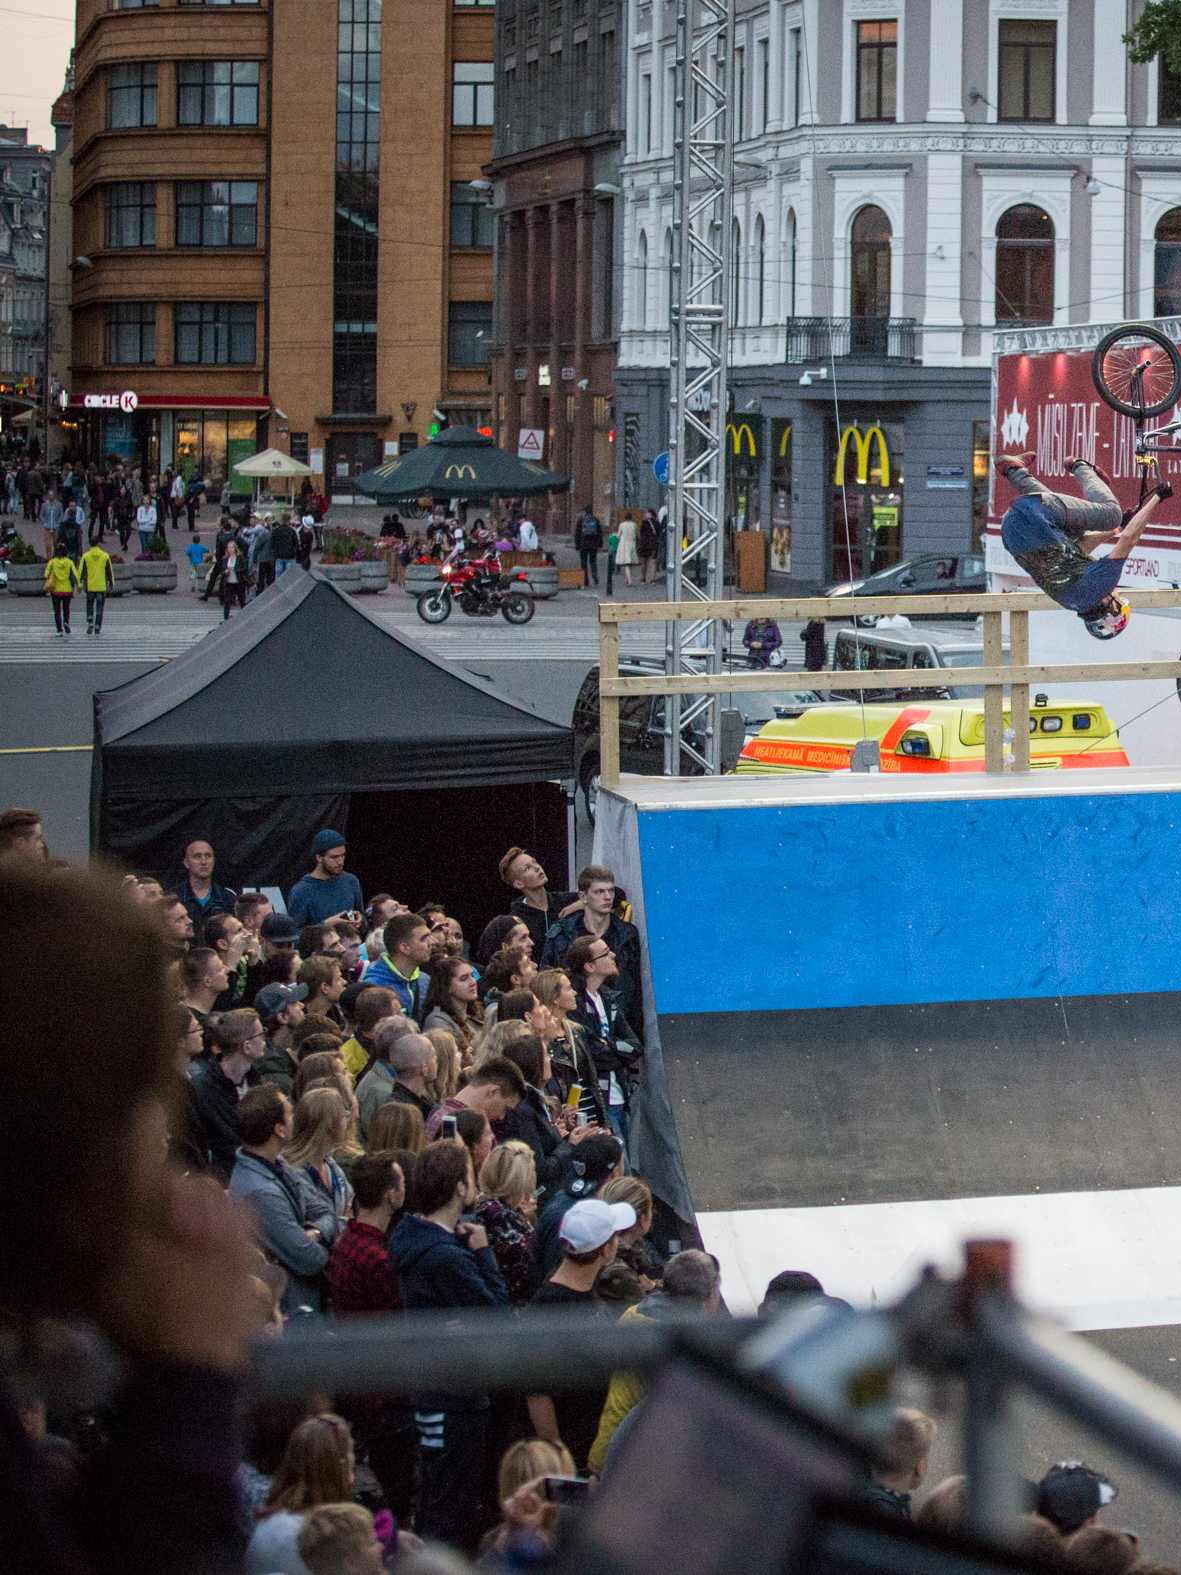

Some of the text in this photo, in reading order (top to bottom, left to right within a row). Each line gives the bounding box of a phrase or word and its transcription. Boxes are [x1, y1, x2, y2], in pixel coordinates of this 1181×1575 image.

[84, 395, 120, 408] CIRCLE
[1036, 394, 1068, 478] MŪSU
[1125, 557, 1160, 578] SPORTLAND
[754, 745, 804, 762] NEATLIEKAMĀ
[806, 750, 851, 767] MEDICĪNISK
